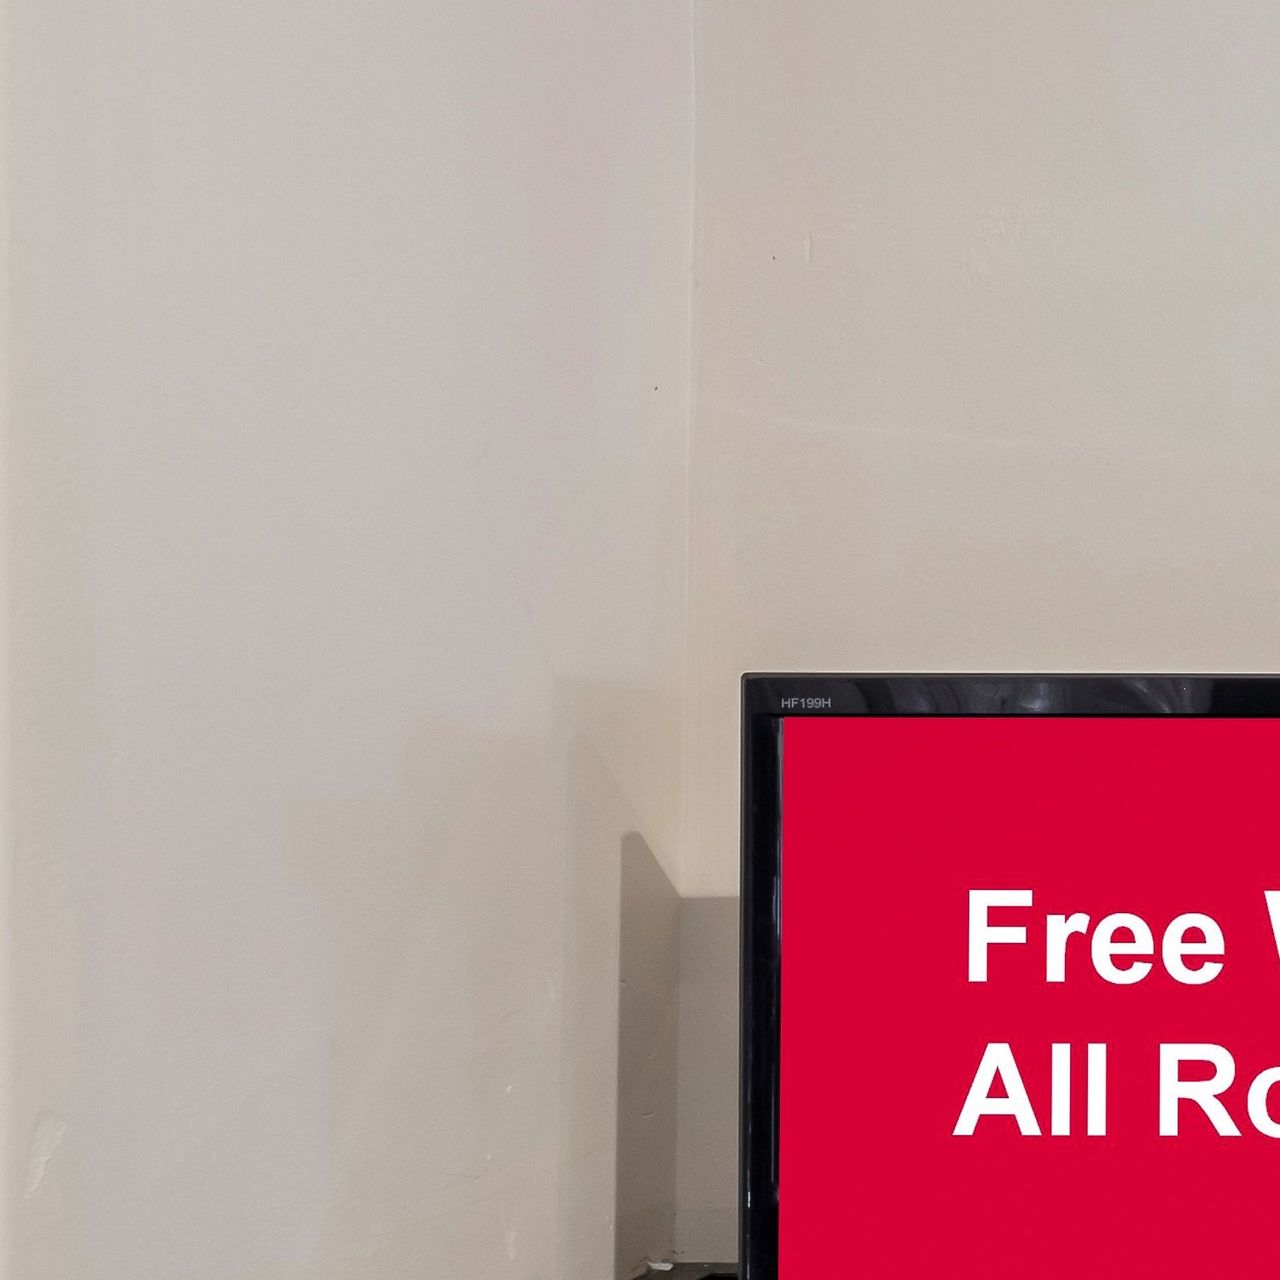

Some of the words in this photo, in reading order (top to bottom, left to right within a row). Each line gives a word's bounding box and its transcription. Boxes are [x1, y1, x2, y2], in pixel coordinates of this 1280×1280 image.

[781, 697, 832, 709] HF199H
[967, 889, 1226, 985] Free
[951, 1042, 1108, 1137] All
